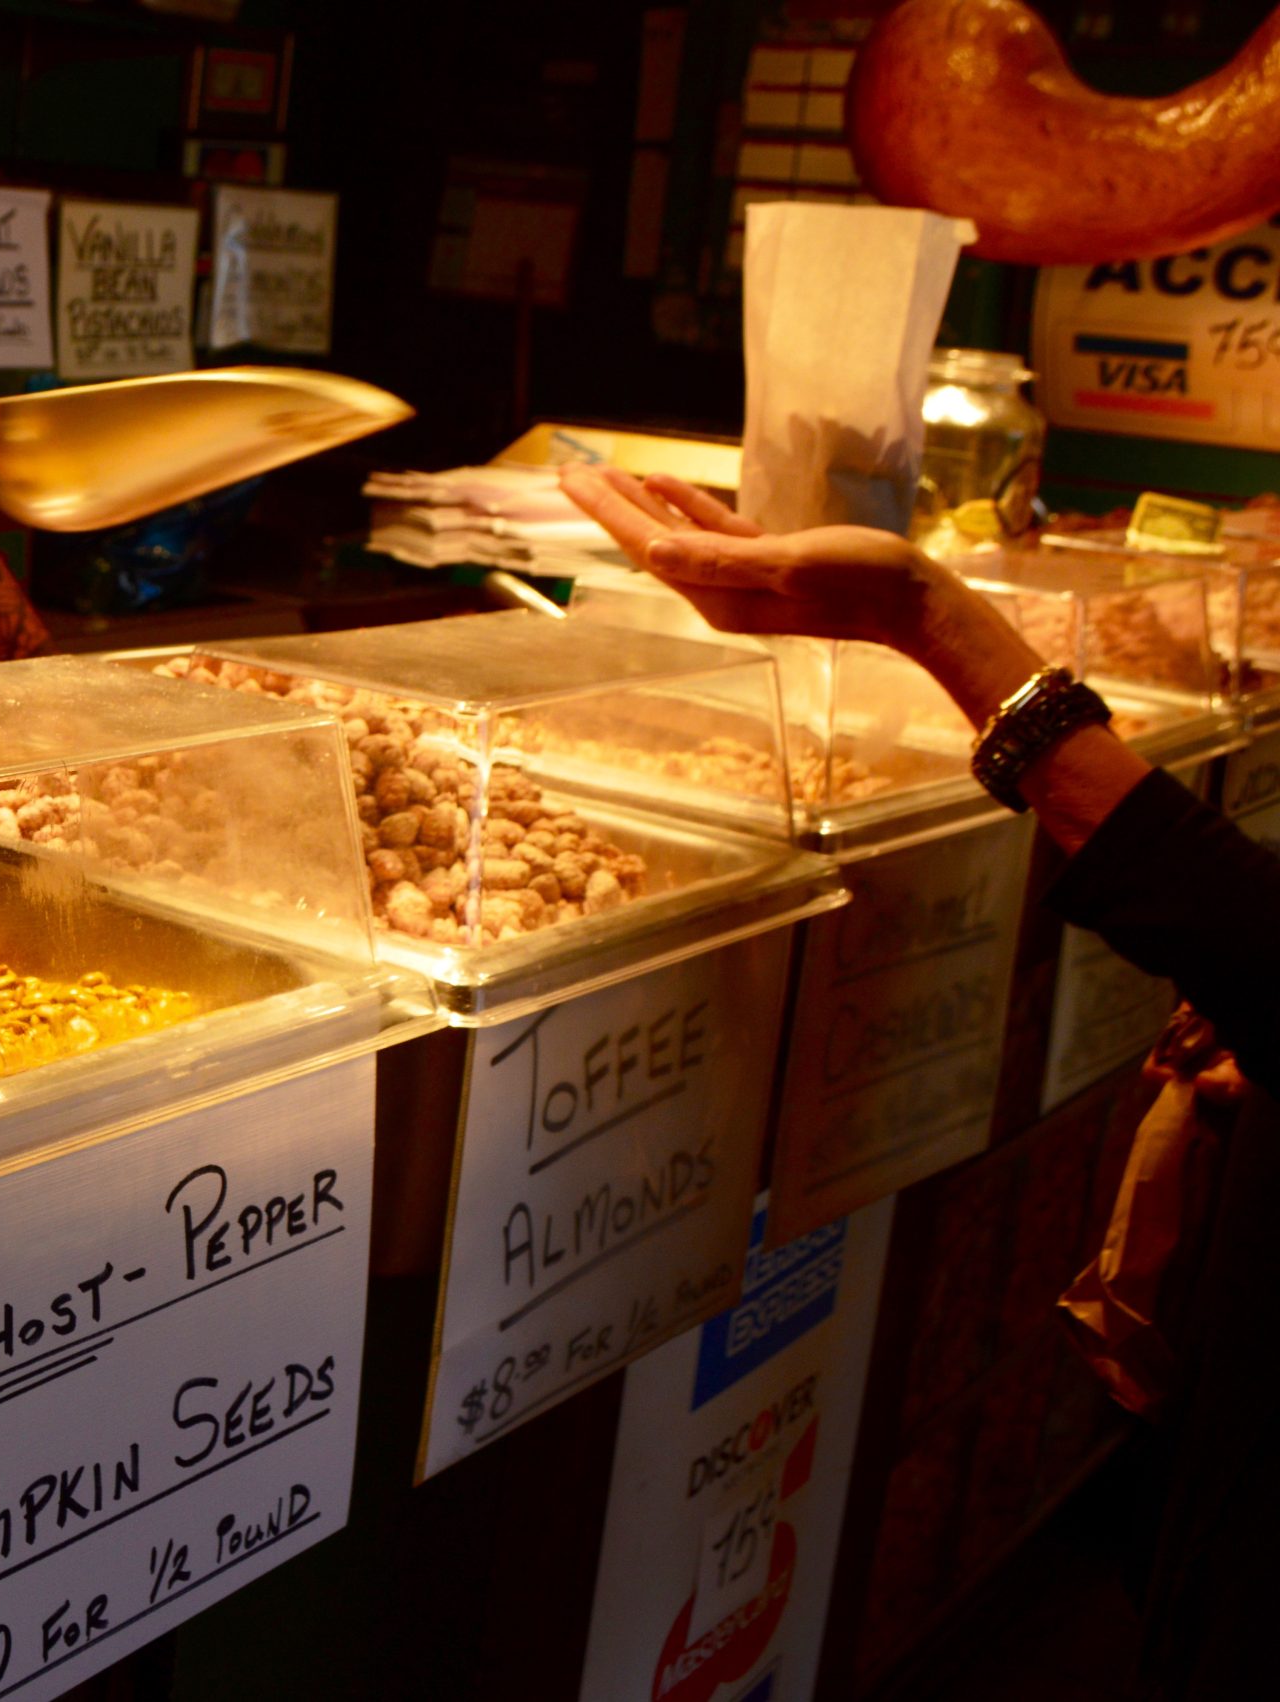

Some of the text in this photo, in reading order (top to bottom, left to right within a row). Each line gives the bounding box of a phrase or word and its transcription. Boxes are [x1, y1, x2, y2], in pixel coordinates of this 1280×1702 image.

[66, 213, 177, 267] VANILLA
[92, 268, 159, 301] BEAN
[1084, 243, 1280, 302] ACC
[1096, 356, 1189, 396] VISA
[491, 1001, 710, 1151] TOFFEE
[165, 1164, 344, 1281] PEPPER
[503, 1134, 715, 1288] ALMONDS
[565, 1325, 613, 1373] FOR
[172, 1355, 337, 1467] SEEDS
[687, 1373, 818, 1498] DISCOVER
[41, 1593, 110, 1663] FOR
[149, 1537, 192, 1605] 1/2
[214, 1483, 312, 1563] POUND
